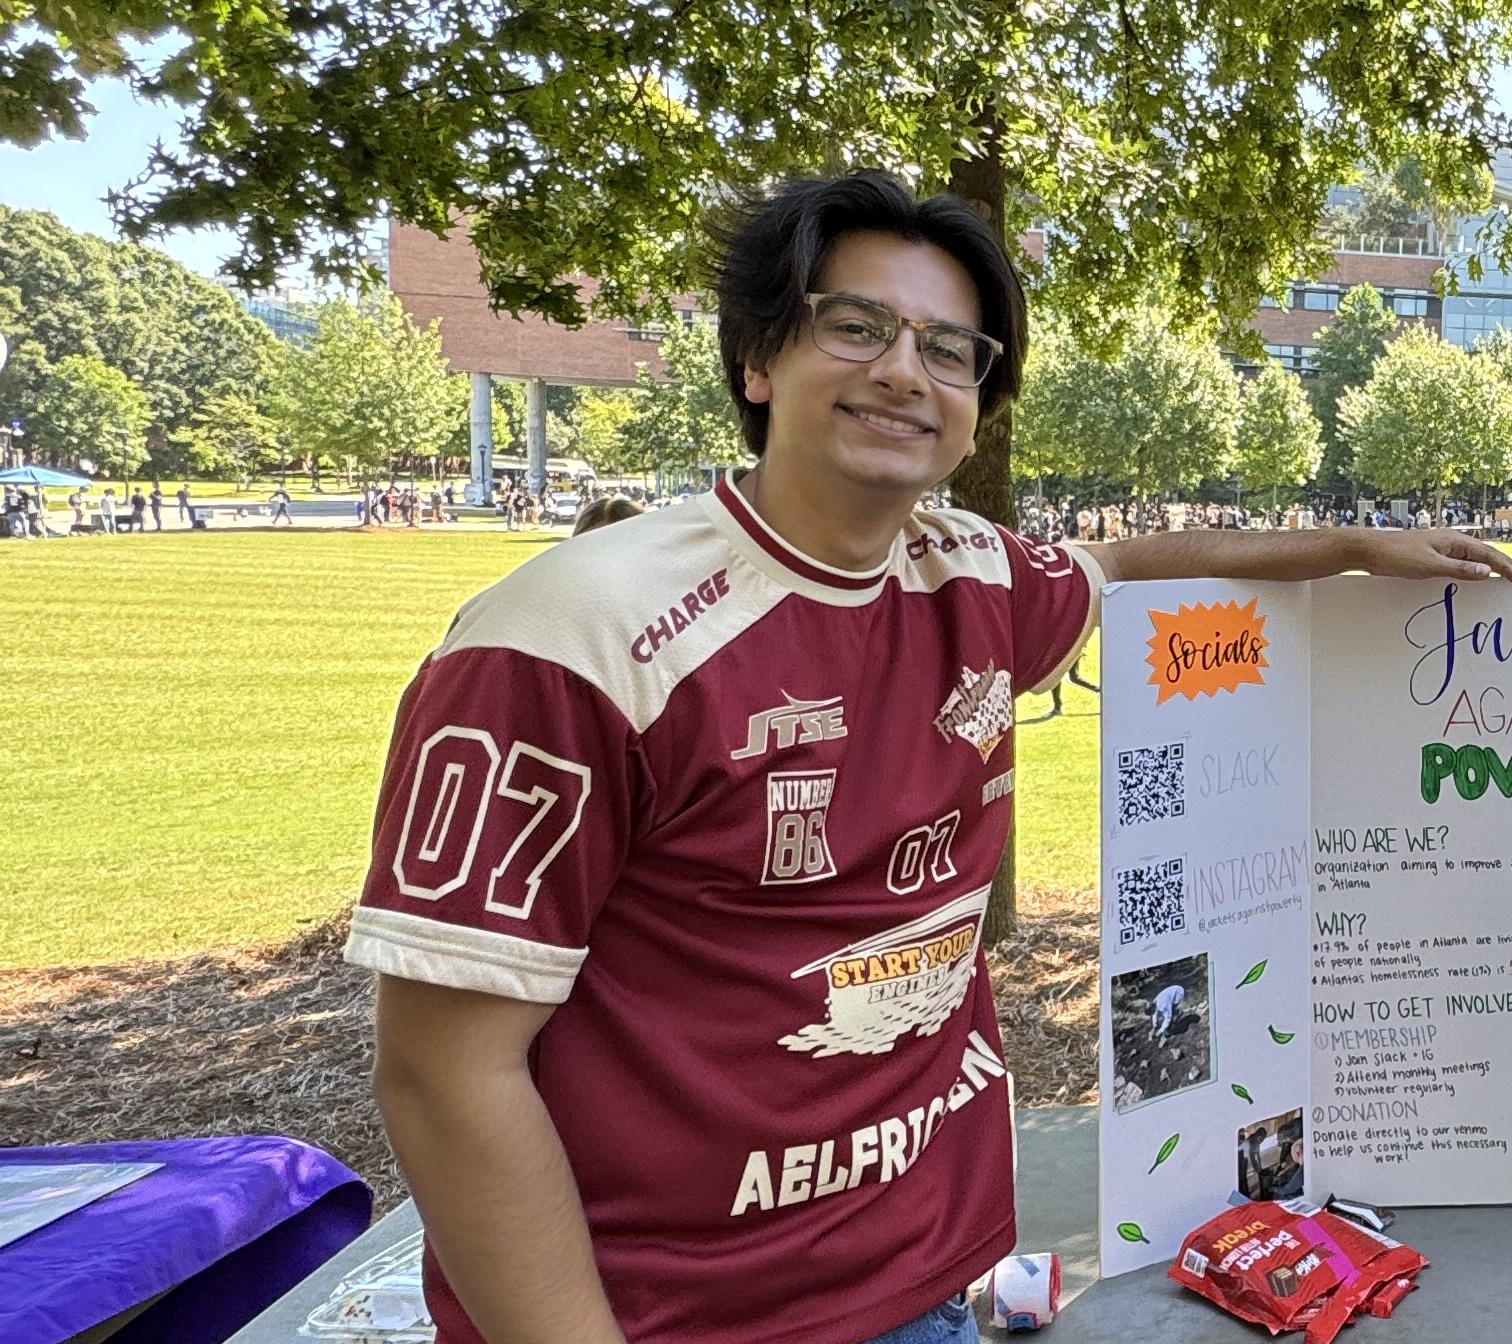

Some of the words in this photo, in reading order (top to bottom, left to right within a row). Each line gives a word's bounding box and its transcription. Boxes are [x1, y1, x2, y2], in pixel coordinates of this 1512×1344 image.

[630, 568, 730, 664] CHARGE
[1166, 630, 1264, 683] Socials
[1200, 744, 1280, 798] SLACK
[770, 778, 834, 811] NUMBER
[392, 724, 592, 920] 07
[772, 811, 825, 878] 86
[887, 809, 961, 895] 07
[1315, 828, 1357, 854] WHO
[1362, 827, 1398, 853] ARE
[1405, 825, 1449, 852] WE?
[1193, 840, 1310, 914] INSTAGRAM
[1401, 859, 1438, 876] aiming
[1445, 856, 1455, 869] to
[1461, 859, 1502, 872] improve
[1317, 882, 1326, 893] in
[1332, 879, 1371, 890] Atlanta
[1198, 895, 1303, 934] @jacketsagainstpoverty
[1315, 911, 1367, 937] WHY?
[831, 948, 921, 989] START
[924, 926, 975, 965] YOUR
[1358, 939, 1370, 952] of
[1377, 939, 1412, 954] people
[1420, 939, 1429, 948] in
[1433, 936, 1468, 948] Atlanta
[1476, 936, 1492, 946] are
[1314, 956, 1326, 968] of
[1331, 956, 1363, 970] people
[1370, 954, 1422, 967] nationally
[1371, 967, 1440, 983] homelessness
[1497, 964, 1505, 975] is
[1313, 1001, 1355, 1024] HOW
[1364, 1000, 1390, 1023] TO
[1397, 996, 1434, 1019] GET
[1331, 1024, 1437, 1051] MEMBERSHIP
[1345, 1055, 1368, 1066] Join
[1374, 1051, 1407, 1067] Slack
[1421, 1048, 1434, 1062] IG
[1347, 1068, 1388, 1084] Attend
[1392, 1066, 1437, 1082] monthly
[1442, 1060, 1490, 1077] meetings
[1403, 1082, 1456, 1097] regularly
[1328, 1099, 1419, 1124] DONATION
[1313, 1128, 1359, 1143] Donate
[1365, 1126, 1411, 1142] directly
[1416, 1125, 1428, 1137] to
[1432, 1126, 1449, 1136] our
[1313, 1147, 1325, 1158] to
[1329, 1144, 1353, 1158] help
[1360, 1143, 1373, 1154] us
[1377, 1141, 1424, 1153] continue
[1431, 1138, 1452, 1150] this
[1457, 1139, 1507, 1154] necessary
[1374, 1152, 1409, 1164] work!
[1212, 1221, 1271, 1255] break
[1236, 1230, 1294, 1271] perfect
